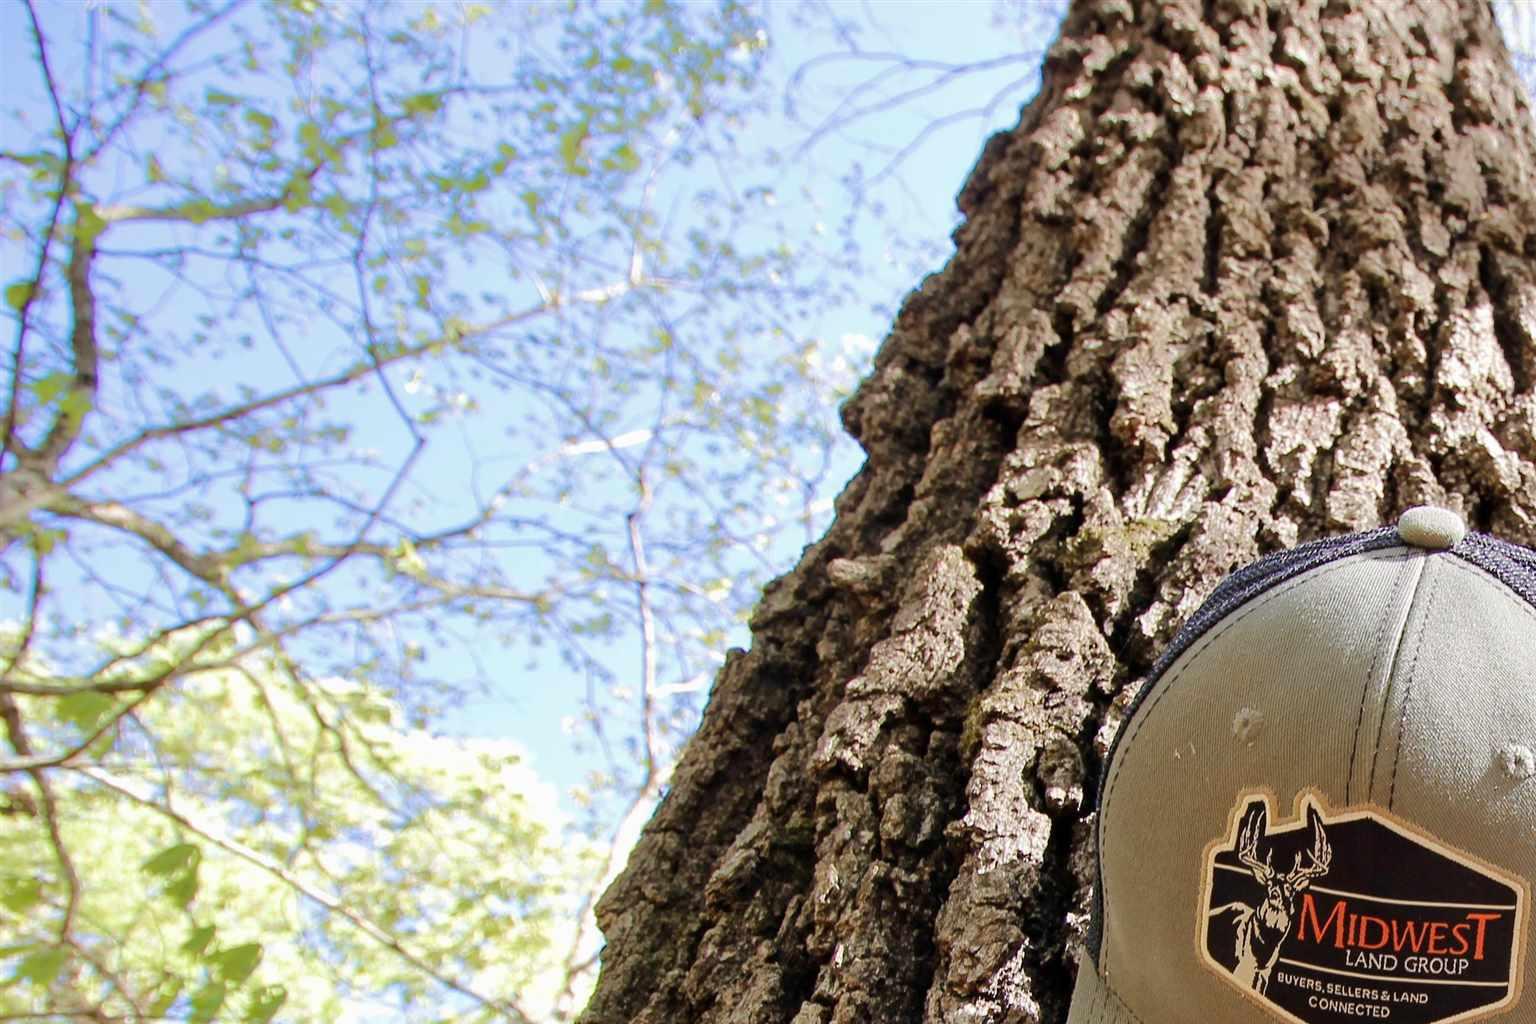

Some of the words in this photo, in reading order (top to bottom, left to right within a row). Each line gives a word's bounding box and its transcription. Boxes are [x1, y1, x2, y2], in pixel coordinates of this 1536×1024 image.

[1297, 893, 1502, 960] MIDWEST
[1345, 949, 1397, 971] LAND
[1404, 956, 1470, 975] GROUP
[1326, 983, 1379, 1001] SELLERS
[1393, 991, 1429, 1005] LAND
[1308, 997, 1391, 1019] CONNECTED
